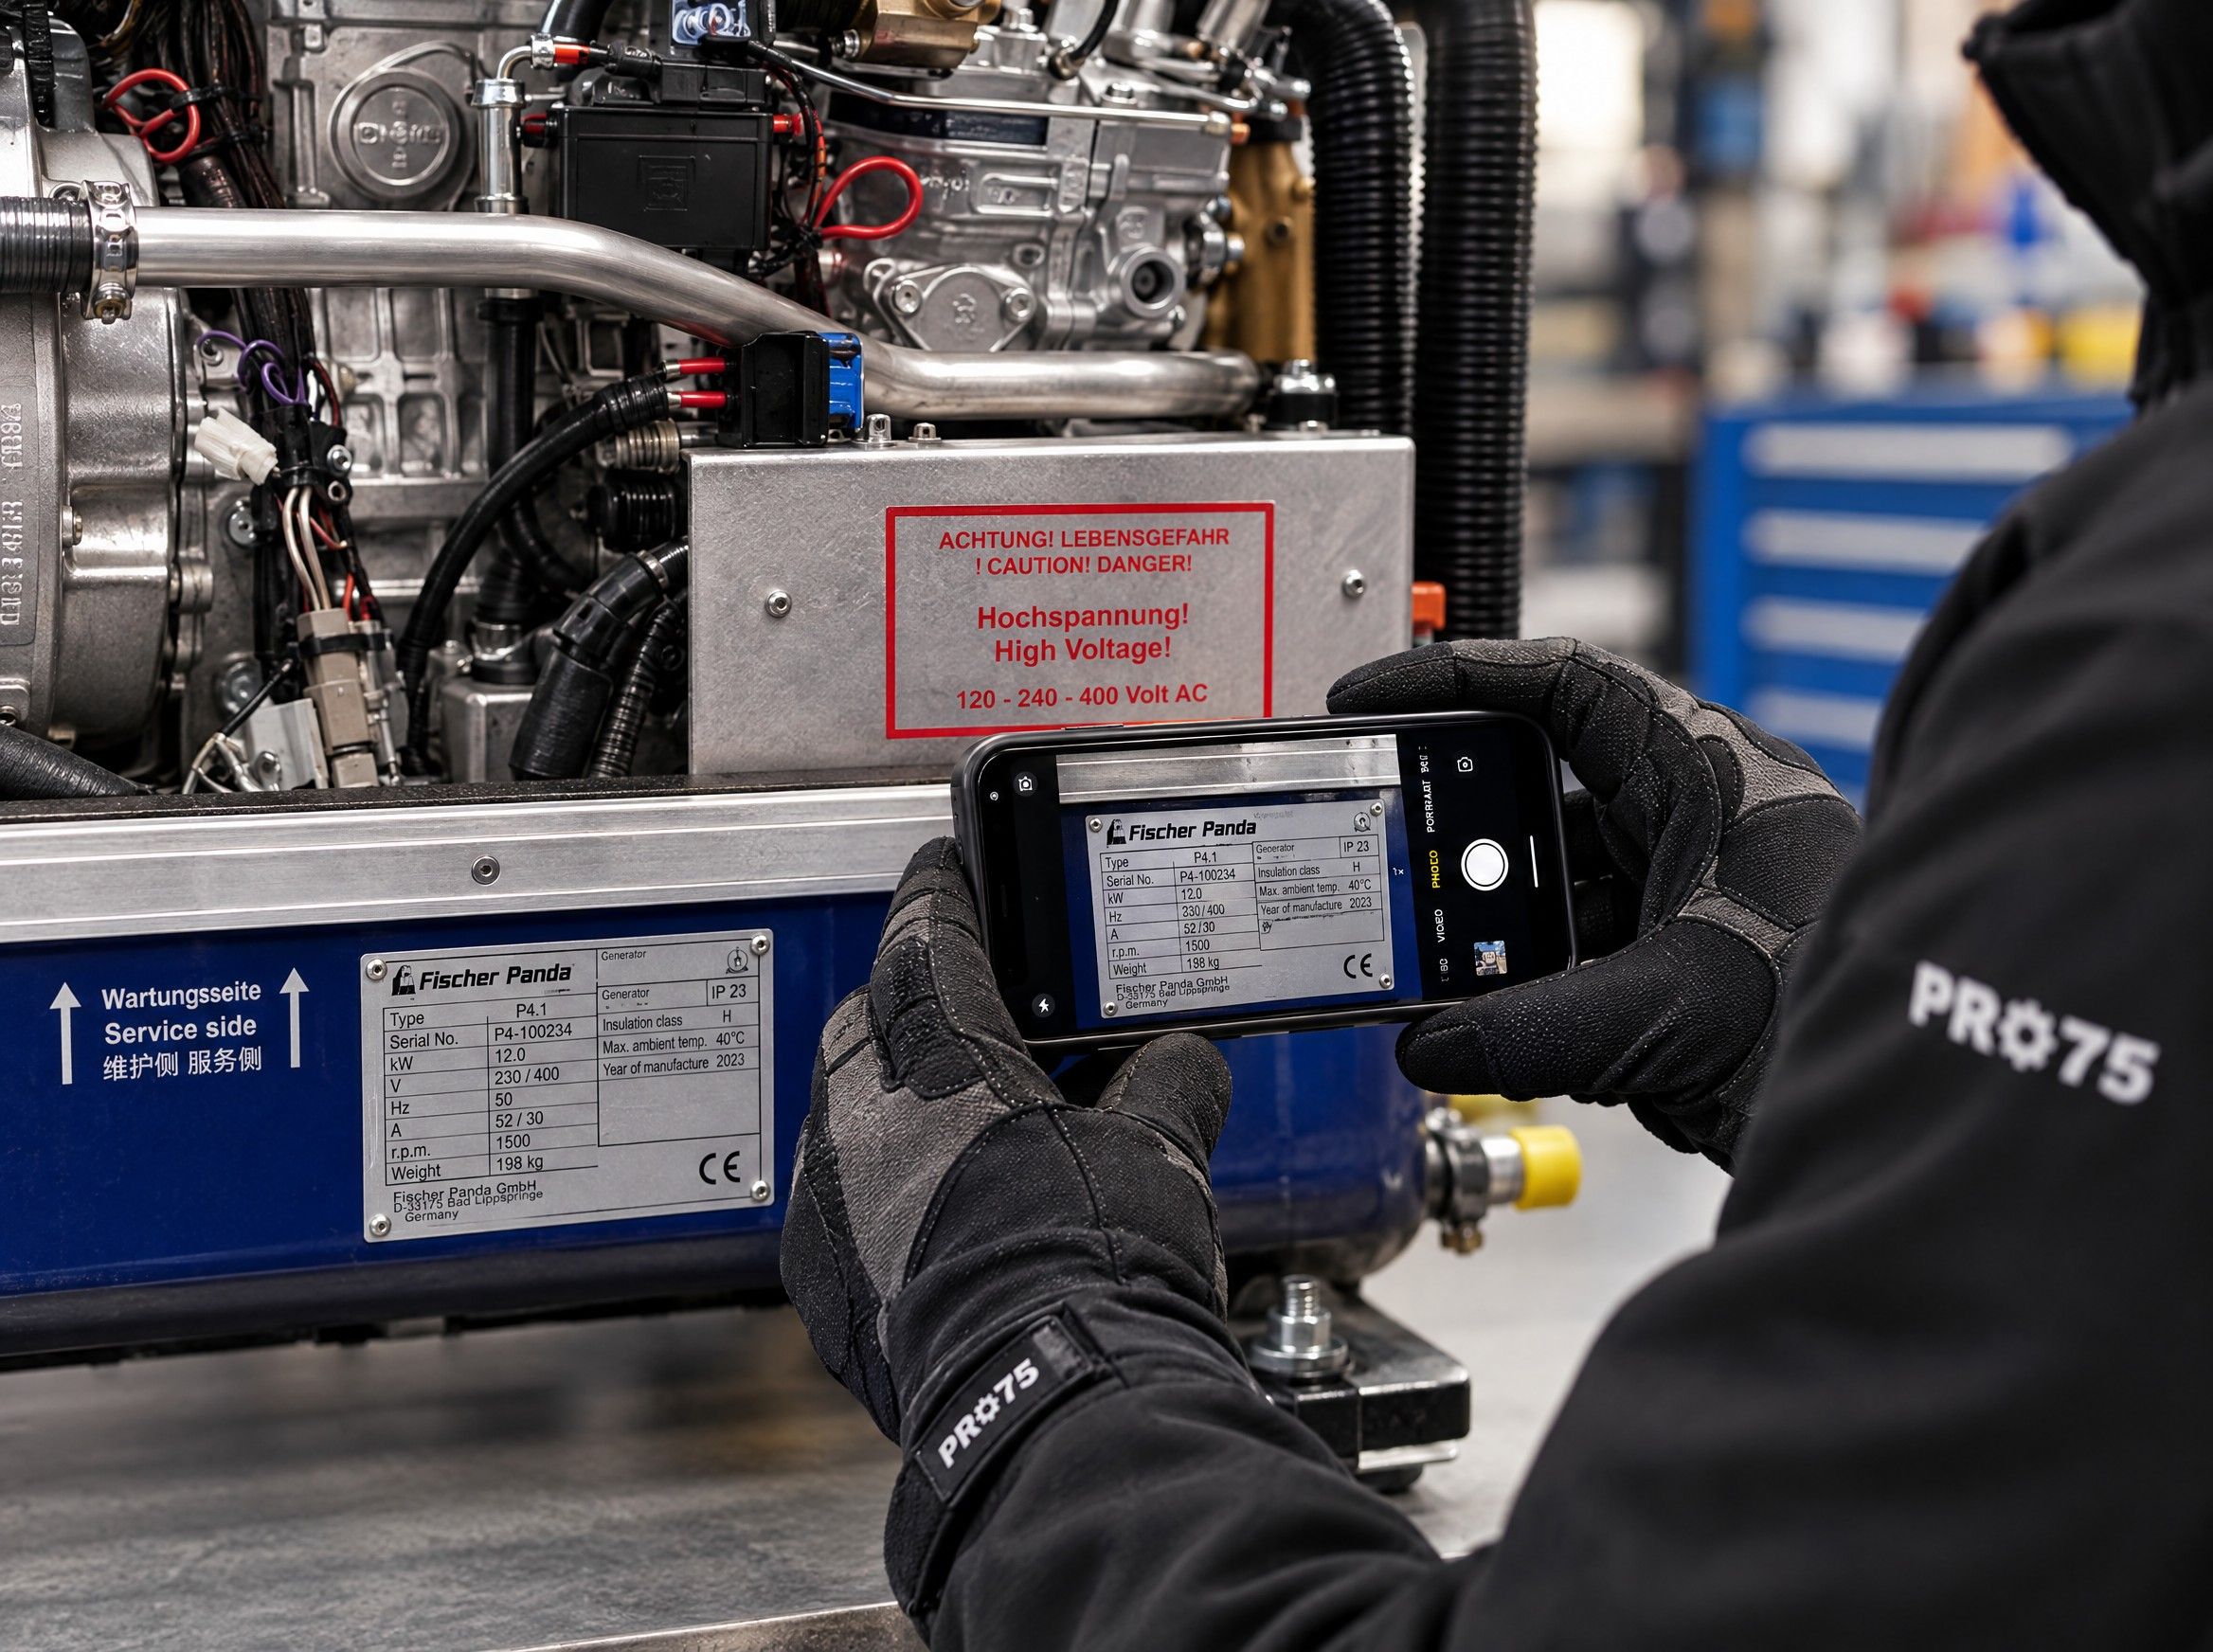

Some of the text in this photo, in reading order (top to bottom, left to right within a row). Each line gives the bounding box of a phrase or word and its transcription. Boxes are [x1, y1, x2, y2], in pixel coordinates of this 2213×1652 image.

[939, 529, 1229, 549] ACHTUNG! LEBENSGEFAHR
[988, 557, 1089, 575] CAUTION!
[1098, 555, 1192, 573] DANGER!
[979, 603, 1188, 631] Hochspannung!
[996, 637, 1171, 667] High Voltage!
[957, 690, 996, 709] 120
[1018, 689, 1057, 708] 240
[1080, 687, 1118, 705] 400
[1125, 685, 1167, 704] Volt
[1176, 684, 1207, 702] AC
[1129, 819, 1256, 840] Fischer Panda
[1344, 841, 1369, 853] IP 23
[1106, 852, 1216, 871] Type P4.1
[1354, 862, 1359, 871] H
[1180, 869, 1235, 883] P4-100234
[1259, 865, 1320, 877] Insulation class
[1107, 874, 1154, 887] Serial No.
[1349, 879, 1371, 890] 40°C
[1181, 888, 1201, 900] 12.0
[1260, 883, 1340, 896] Max. ambient temp.
[1108, 892, 1123, 904] kW
[1350, 897, 1372, 908] 2023
[1261, 901, 1342, 915] Year of manufacture
[1109, 911, 1122, 923] Hz
[1111, 928, 1118, 940] A
[1186, 940, 1210, 951] 1500
[602, 950, 646, 961] Generator
[1112, 947, 1139, 960] r.p.m.
[1113, 962, 1146, 976] Weight
[1209, 957, 1219, 969] kg
[420, 963, 571, 990] Fischer Panda
[712, 984, 746, 998] IP 23
[1116, 977, 1227, 993] Fischer Panda GmbH
[102, 981, 261, 1010] Wartungsseite
[603, 988, 649, 999] Generator
[1126, 999, 1168, 1009] Germany
[390, 1003, 547, 1028] Type P4.1
[603, 1015, 682, 1031] Insulation class
[724, 1010, 731, 1023] H
[105, 1015, 256, 1045] Service side
[495, 1023, 572, 1041] P4-100234
[390, 1032, 458, 1049] Serial No.
[603, 1035, 707, 1053] Max. ambient temp.
[716, 1032, 745, 1046] 40°C
[495, 1048, 525, 1063] 12.0
[717, 1053, 745, 1068] 2023
[103, 1046, 261, 1081] 维护侧 服务侧
[391, 1056, 413, 1071] kW
[603, 1058, 709, 1076] Year of manufacture
[495, 1070, 521, 1086] 230
[534, 1067, 559, 1082] 400
[391, 1079, 401, 1092] V
[495, 1092, 512, 1106] 50
[391, 1102, 409, 1115] Hz
[495, 1114, 513, 1128] 52
[527, 1111, 543, 1124] 30
[391, 1123, 402, 1137] A
[496, 1134, 531, 1150] 1500
[392, 1145, 430, 1160] r.p.m.
[496, 1156, 543, 1171] 198 kg
[392, 1164, 441, 1181] Weight
[394, 1180, 535, 1203] Fischer Panda GmbH
[394, 1190, 543, 1212] D-33175 Bad Lippspringe
[405, 1211, 459, 1222] Germany
